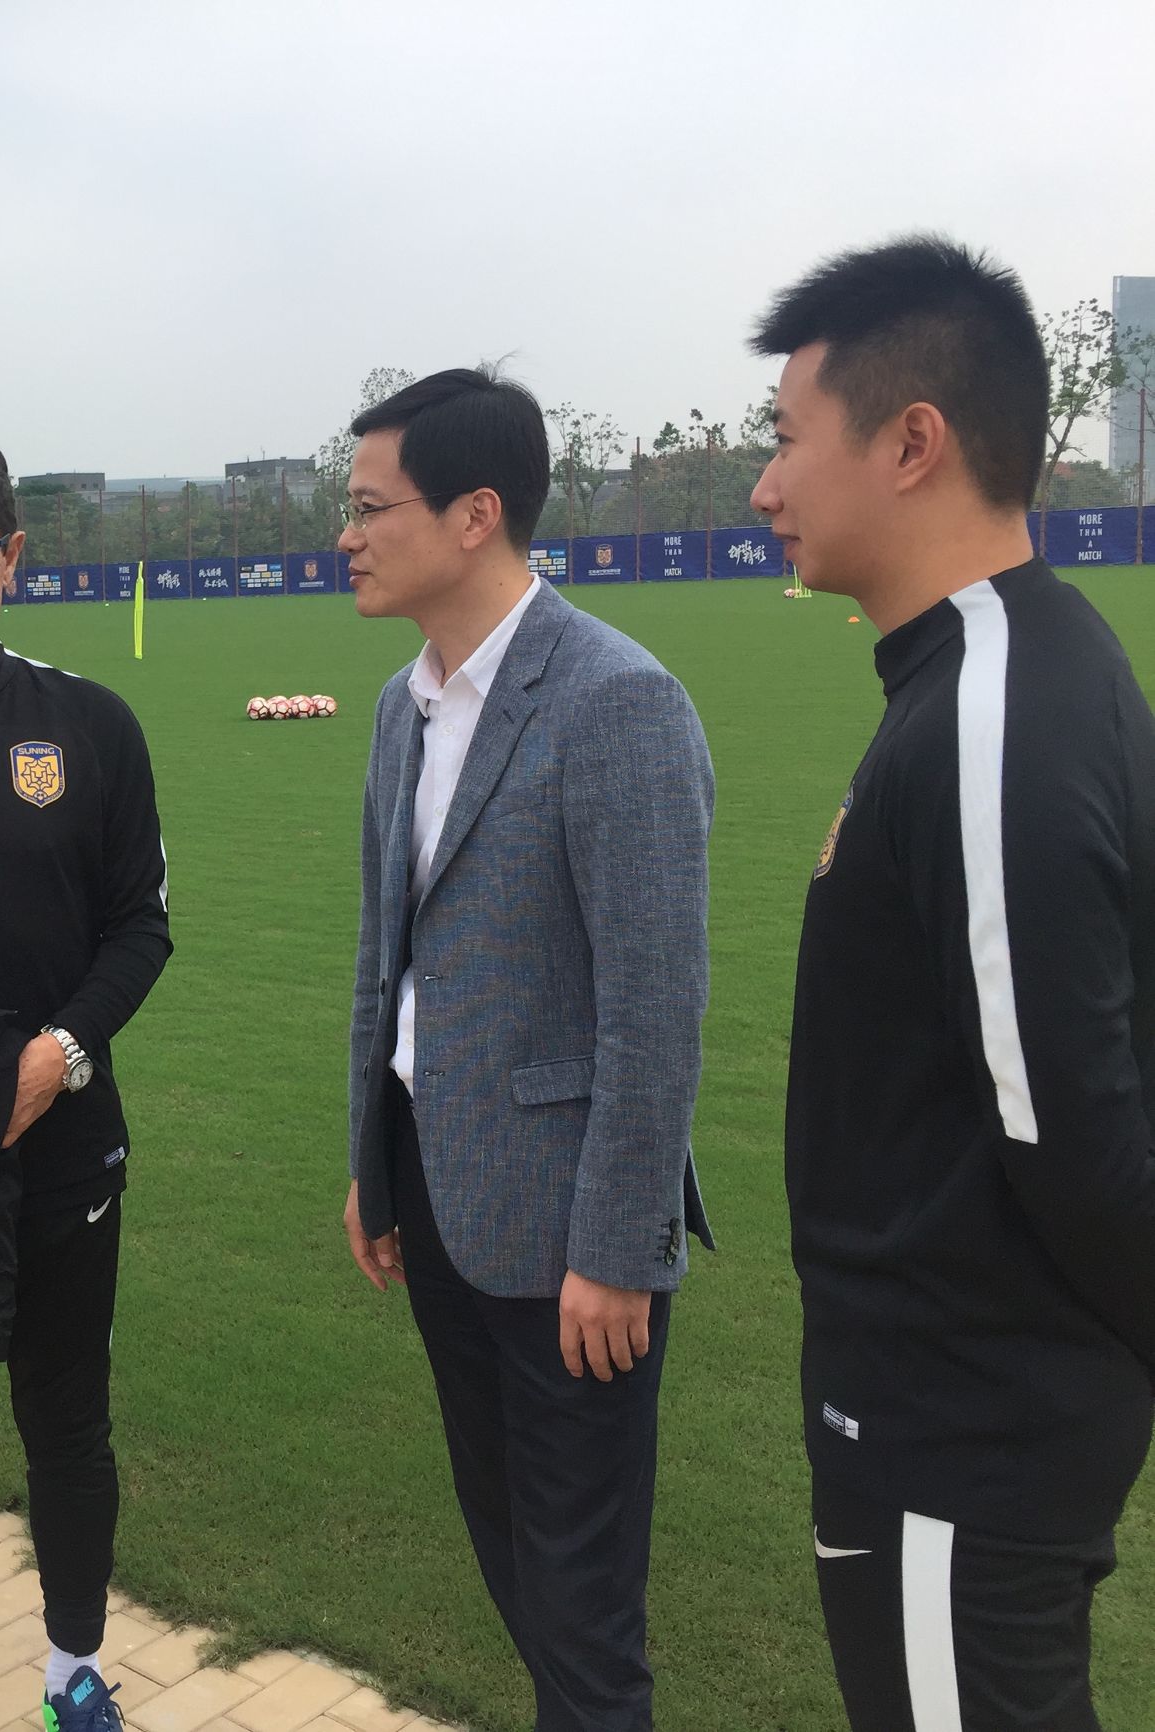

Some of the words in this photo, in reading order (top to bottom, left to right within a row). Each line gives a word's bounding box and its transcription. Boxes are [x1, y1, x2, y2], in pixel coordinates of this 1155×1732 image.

[1079, 514, 1102, 525] MORE
[664, 536, 682, 546] MORE
[1088, 540, 1093, 548] A
[1078, 551, 1102, 560] MATCH
[664, 567, 682, 576] MATCH
[17, 747, 55, 755] SUNING
[71, 1675, 95, 1706] NIKE
